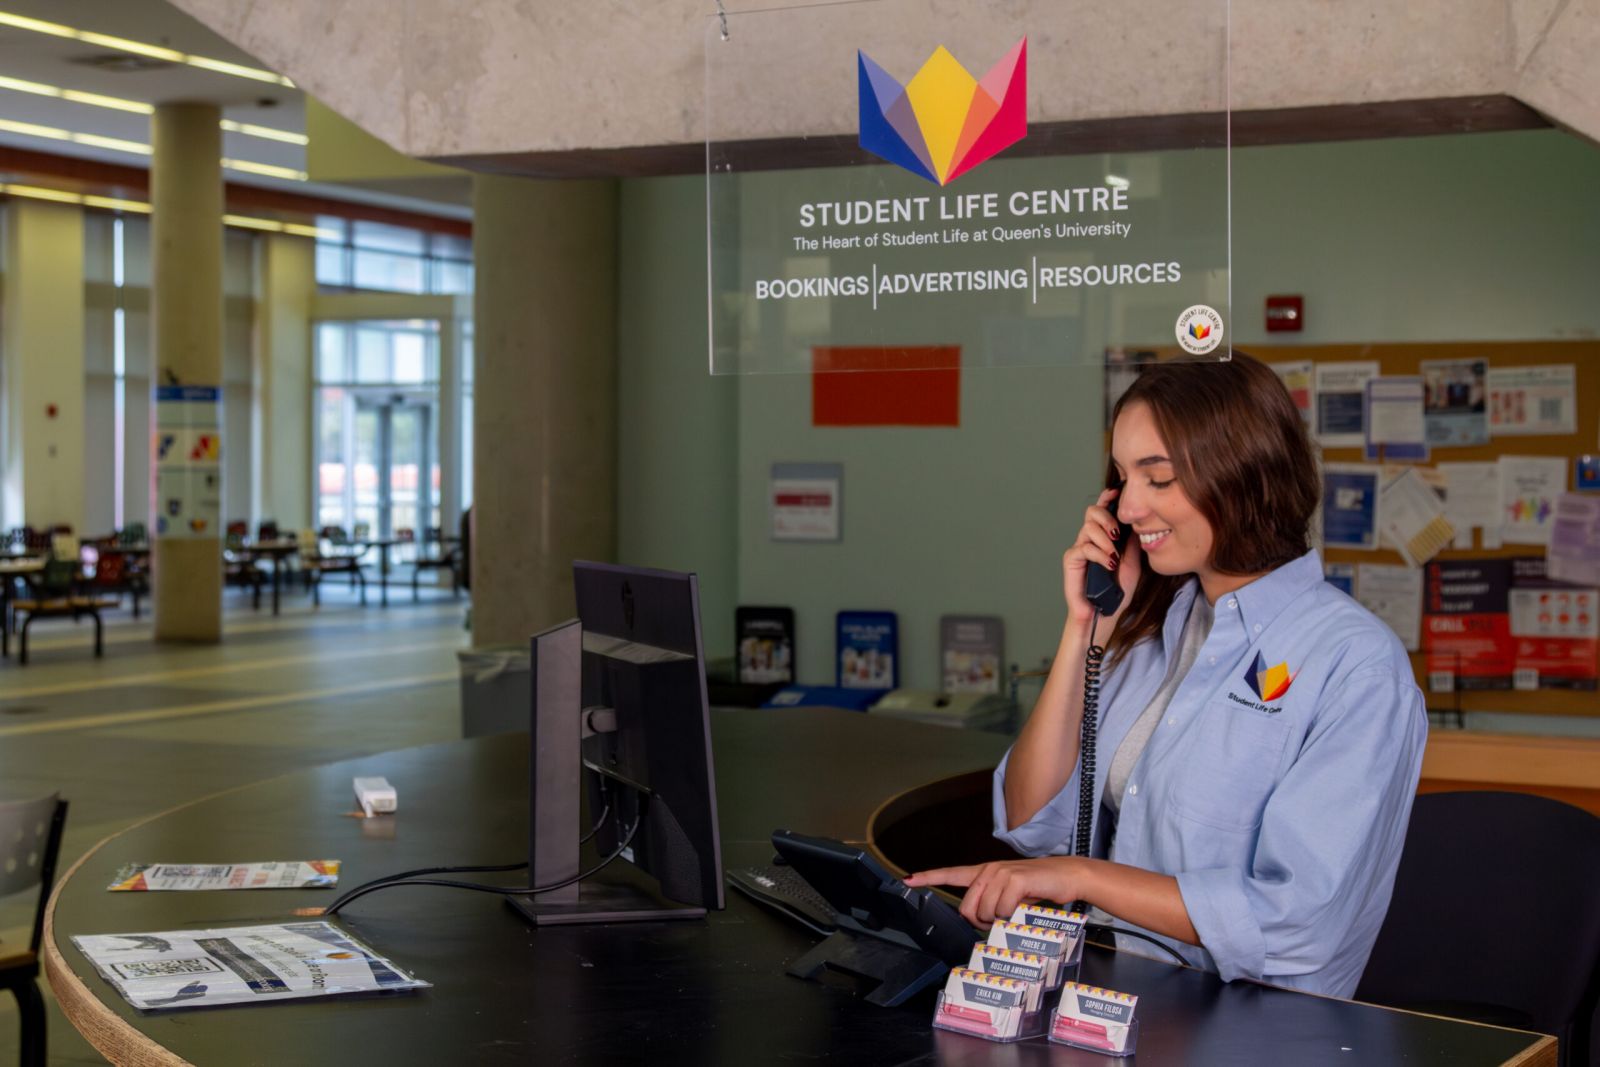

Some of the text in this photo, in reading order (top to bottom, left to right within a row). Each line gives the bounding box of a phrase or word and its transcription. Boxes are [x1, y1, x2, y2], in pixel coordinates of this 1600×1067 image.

[799, 186, 1129, 228] STUDENT LIFE CENTRE
[793, 221, 1132, 251] The Heart of Student Life at Queen's University
[755, 261, 1182, 300] BOOKINGS ADVERTISING RESOURCES
[1228, 692, 1255, 708] Student
[1255, 703, 1268, 712] Life
[1061, 923, 1078, 931] SINGH
[1021, 939, 1041, 950] PHOEBE
[991, 962, 1010, 972] RUSLAN
[976, 989, 992, 998] ERIKA
[992, 992, 1003, 1000] KIM
[1085, 1000, 1104, 1010] SOPHIA
[1104, 1003, 1123, 1015] FILOSA
